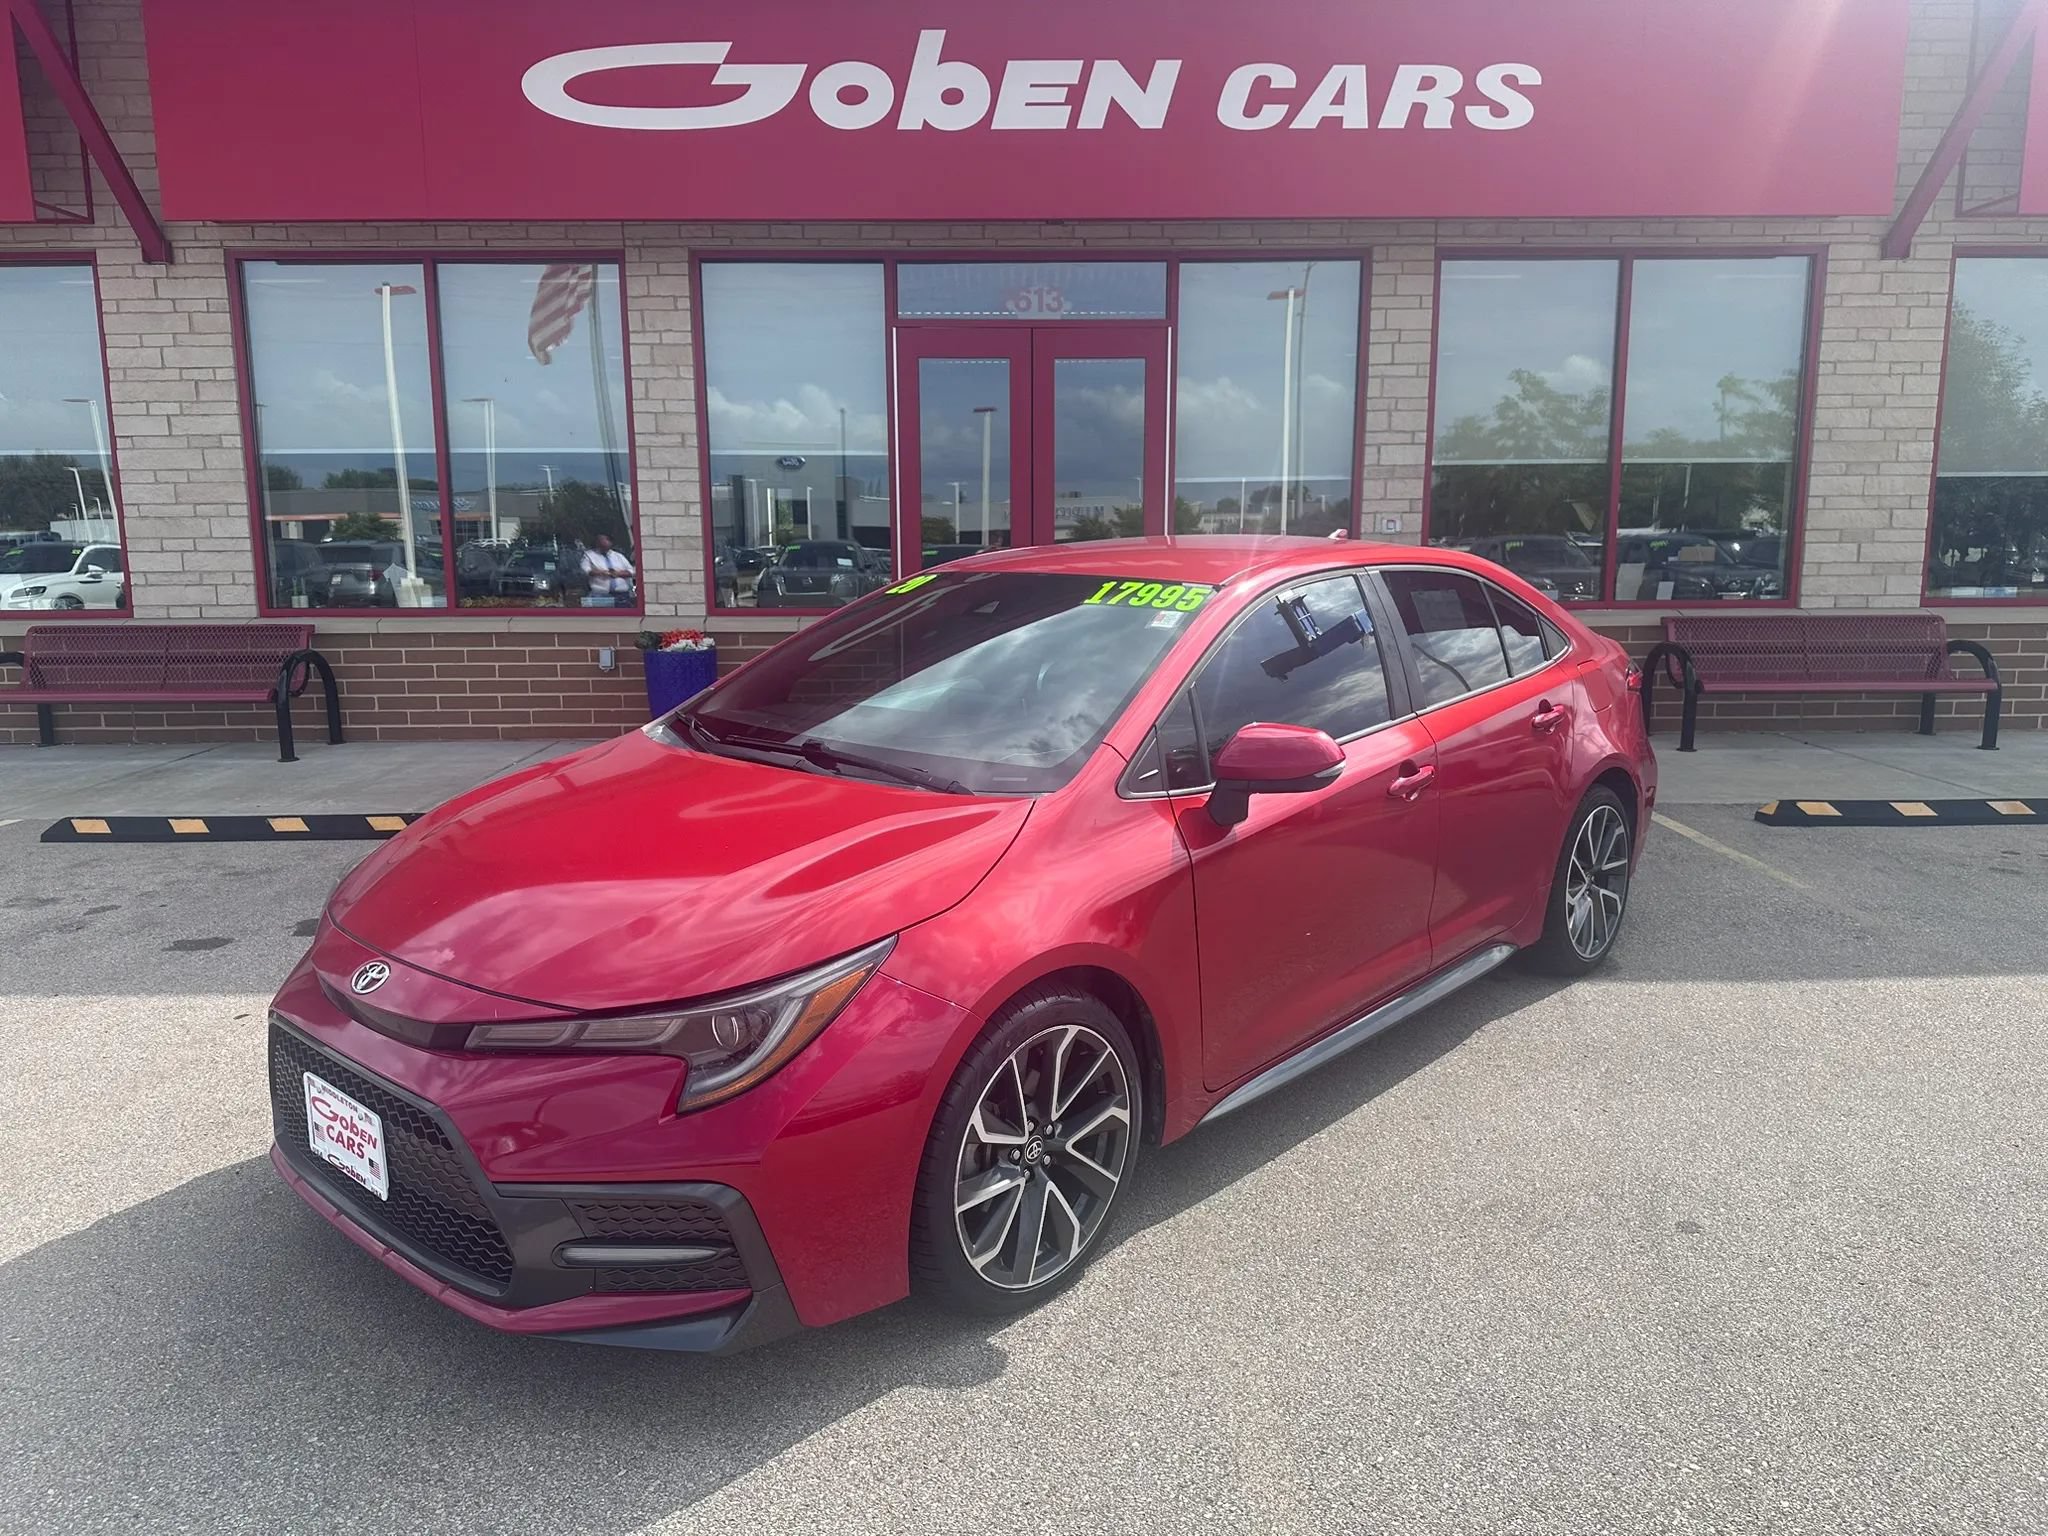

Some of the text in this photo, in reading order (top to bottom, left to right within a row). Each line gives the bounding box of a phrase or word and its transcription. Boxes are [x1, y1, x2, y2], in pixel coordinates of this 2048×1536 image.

[1216, 62, 1542, 131] CARS
[1083, 581, 1213, 612] 17995
[325, 1124, 366, 1160] CARS
